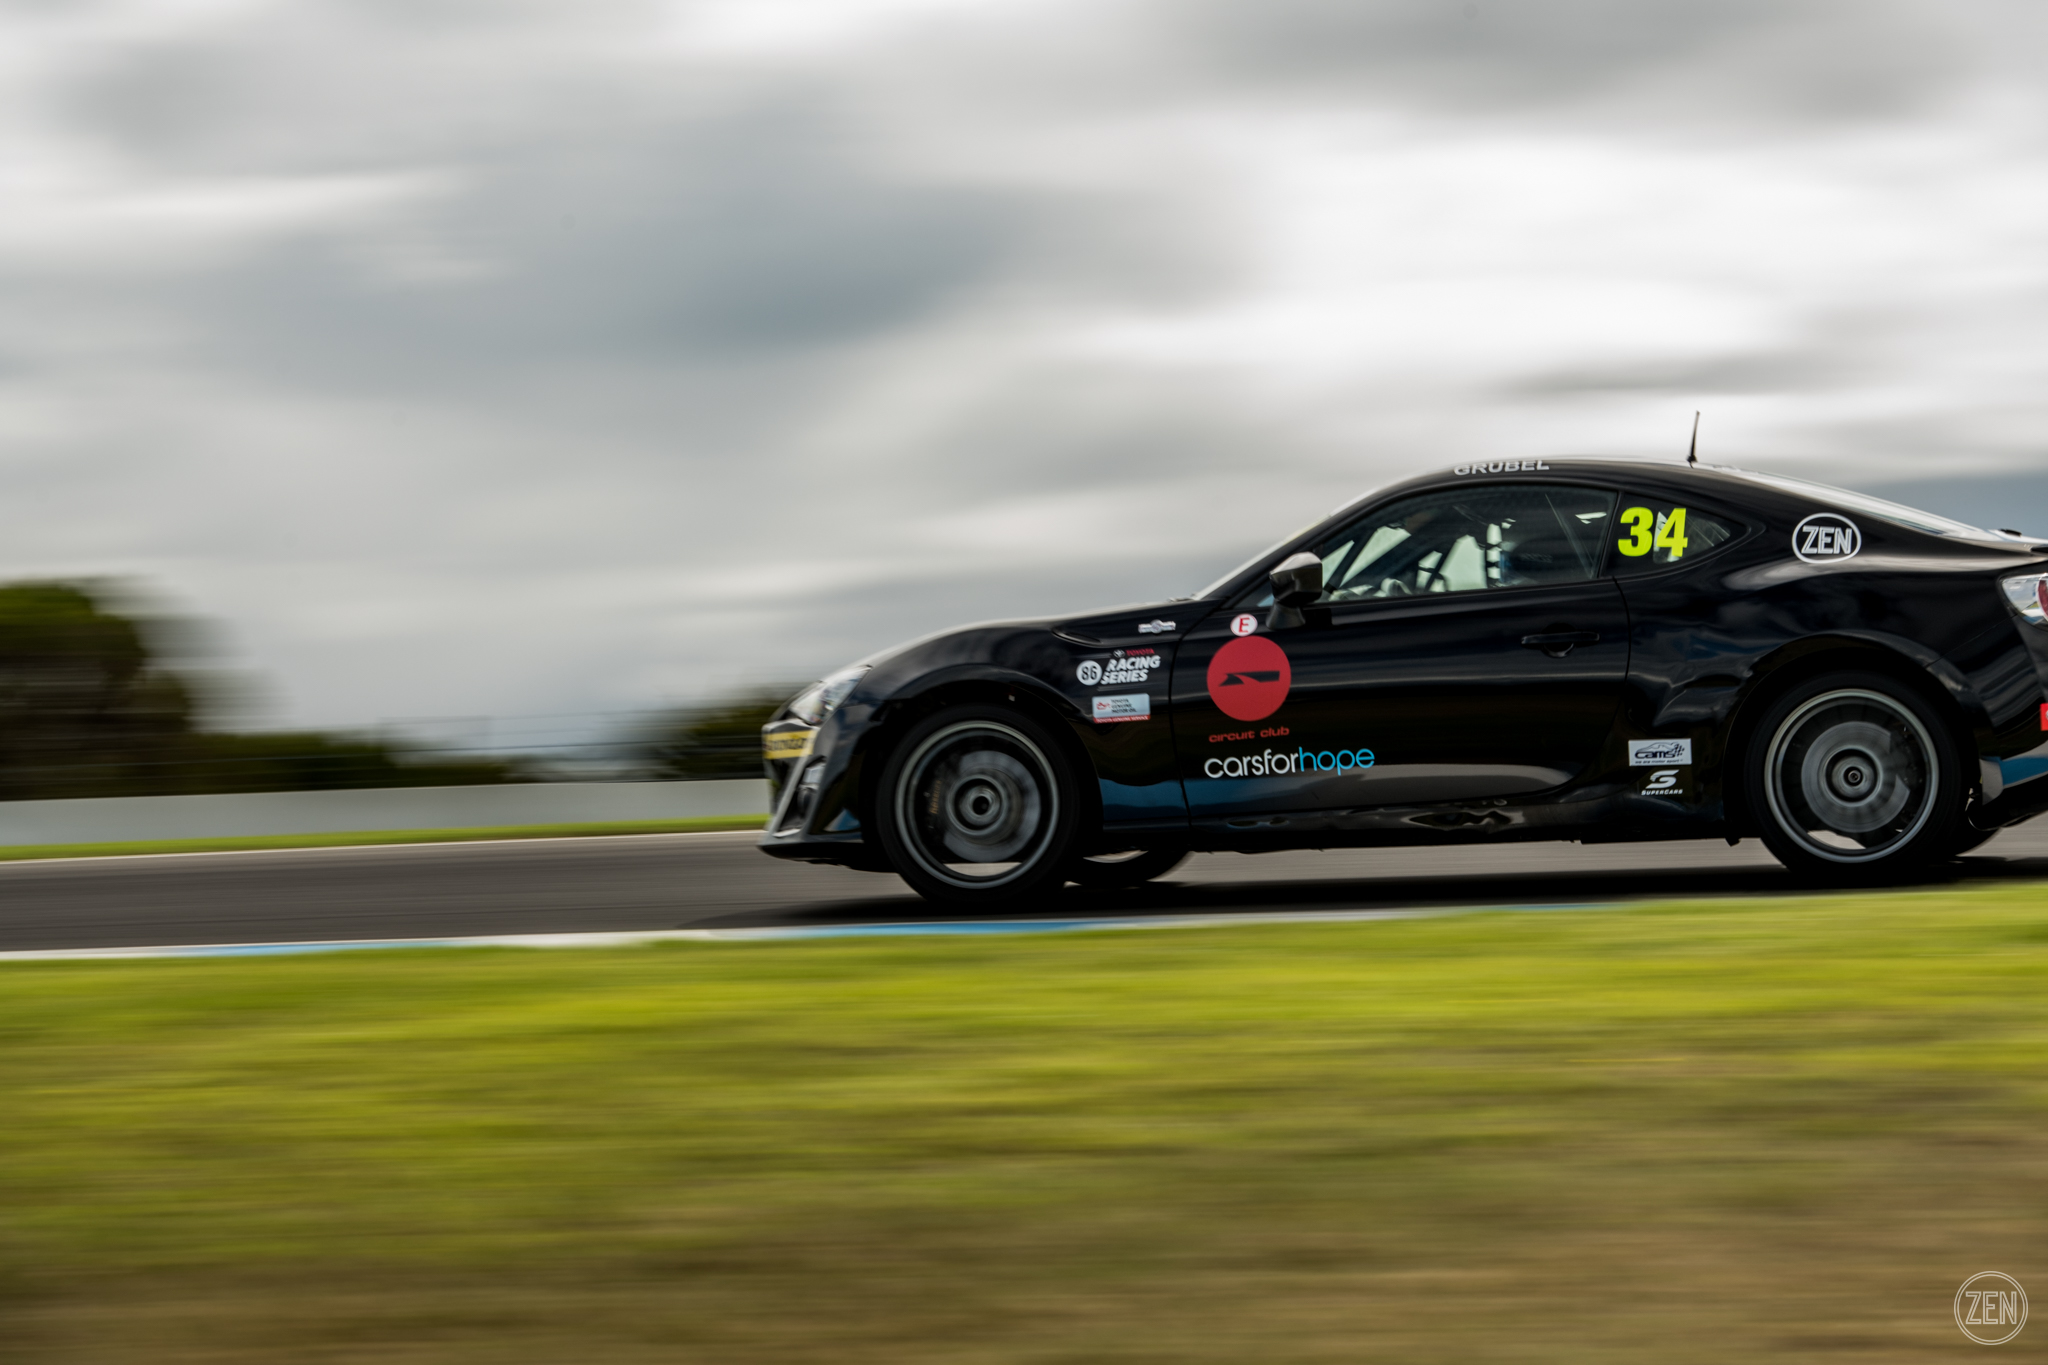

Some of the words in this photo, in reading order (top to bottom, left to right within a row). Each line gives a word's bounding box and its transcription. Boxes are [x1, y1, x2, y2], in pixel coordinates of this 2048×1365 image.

[1454, 460, 1550, 476] GRUBEL
[1617, 506, 1688, 557] 34
[1801, 525, 1853, 554] ZEN
[1238, 617, 1251, 633] E
[1126, 648, 1155, 656] TOYOTA
[1106, 655, 1161, 672] RACING
[1081, 665, 1098, 681] 86
[1101, 669, 1149, 685] SERIES
[1209, 730, 1255, 743] circuit
[1260, 726, 1290, 738] club
[1204, 746, 1375, 778] carsforhope
